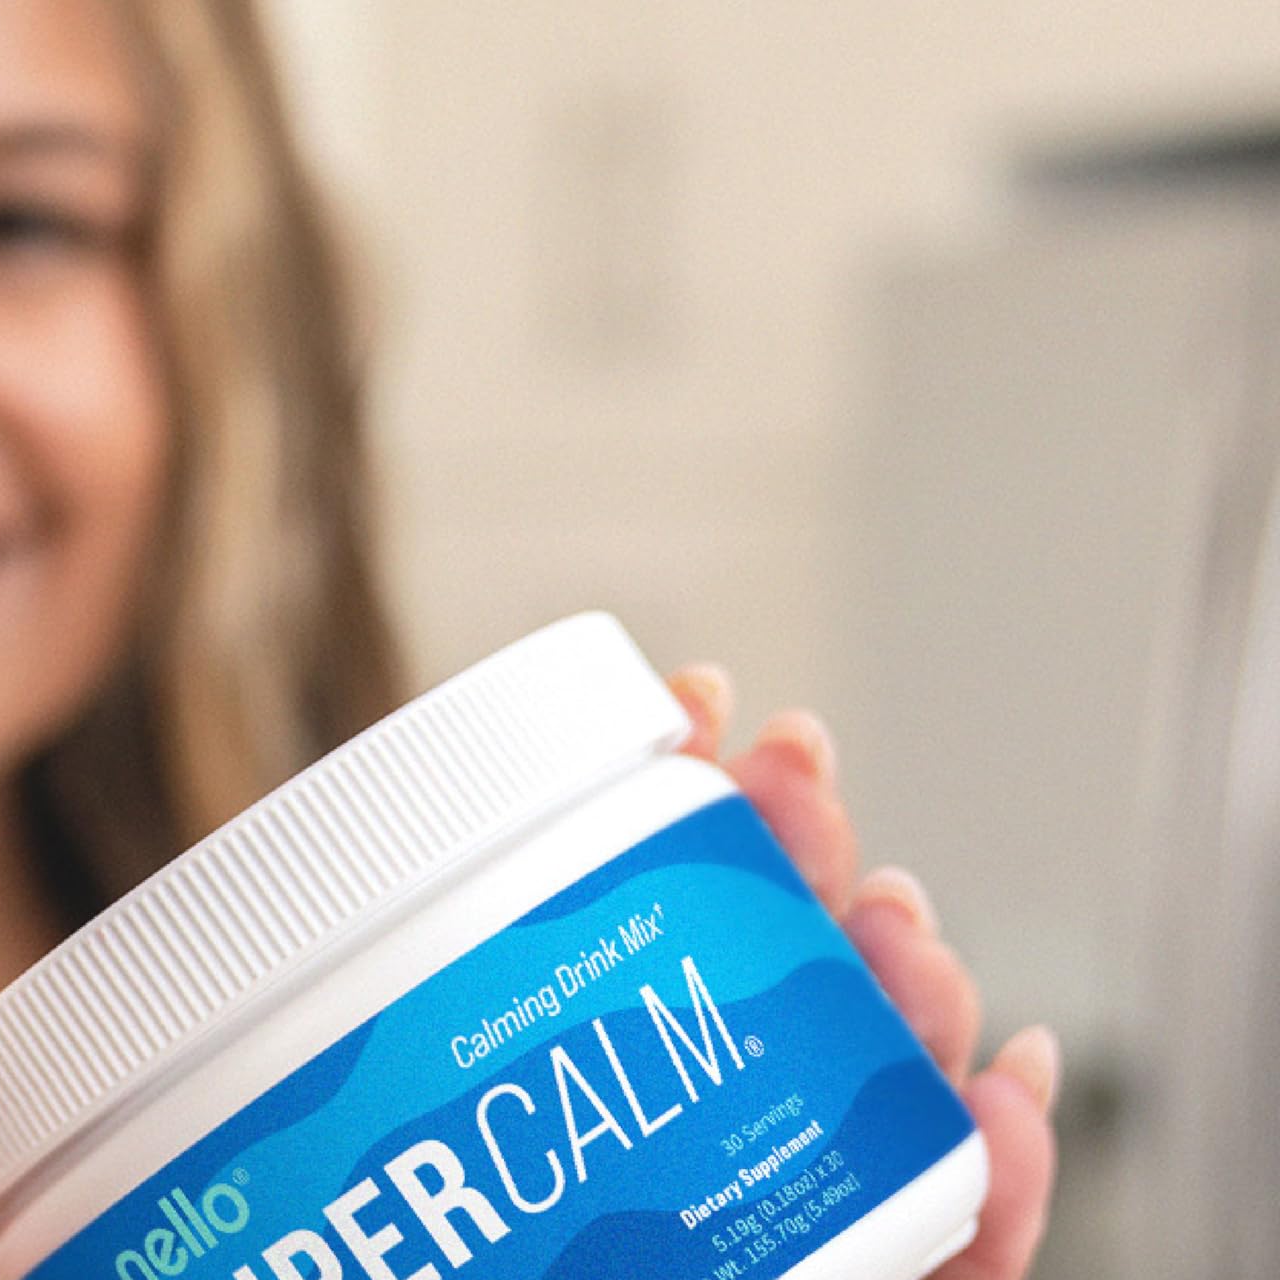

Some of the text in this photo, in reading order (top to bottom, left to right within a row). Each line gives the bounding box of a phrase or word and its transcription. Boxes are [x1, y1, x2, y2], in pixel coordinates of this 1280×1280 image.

[451, 984, 561, 1068] Calming
[555, 937, 623, 998] Drink
[680, 1119, 824, 1230] Dietary Supplement
[720, 1093, 803, 1157] 30 Servings
[711, 1212, 763, 1252] 5.19g
[759, 1168, 820, 1222] (0.18oz)
[822, 1150, 845, 1171] 30
[745, 1211, 811, 1265] 155.70g
